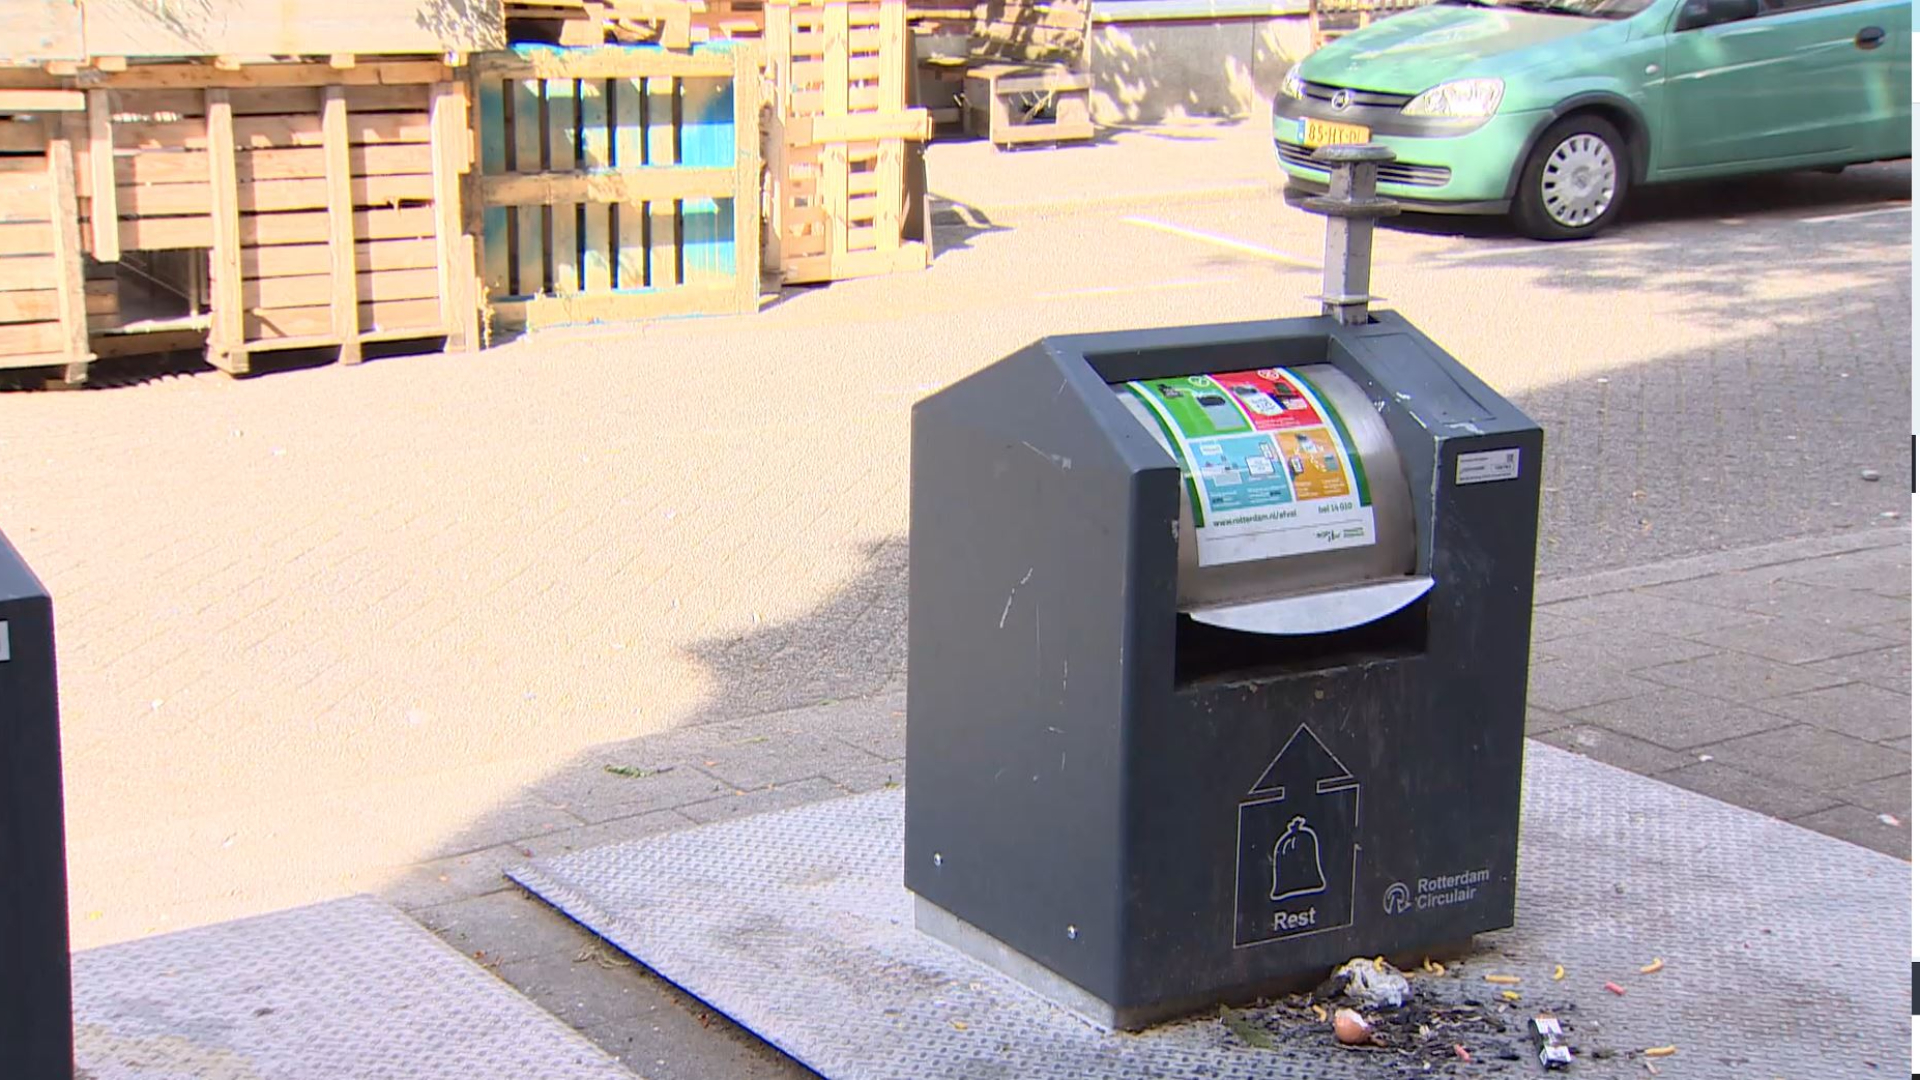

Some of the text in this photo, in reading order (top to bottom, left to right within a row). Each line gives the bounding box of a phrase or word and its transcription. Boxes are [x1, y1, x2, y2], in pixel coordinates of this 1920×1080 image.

[1213, 510, 1297, 526] www.rotterdam.nl/afval
[1318, 502, 1353, 514] bel 14 010
[1418, 869, 1490, 893] Rotterdam
[1417, 886, 1477, 910] Circulair
[1274, 907, 1316, 932] Rest
